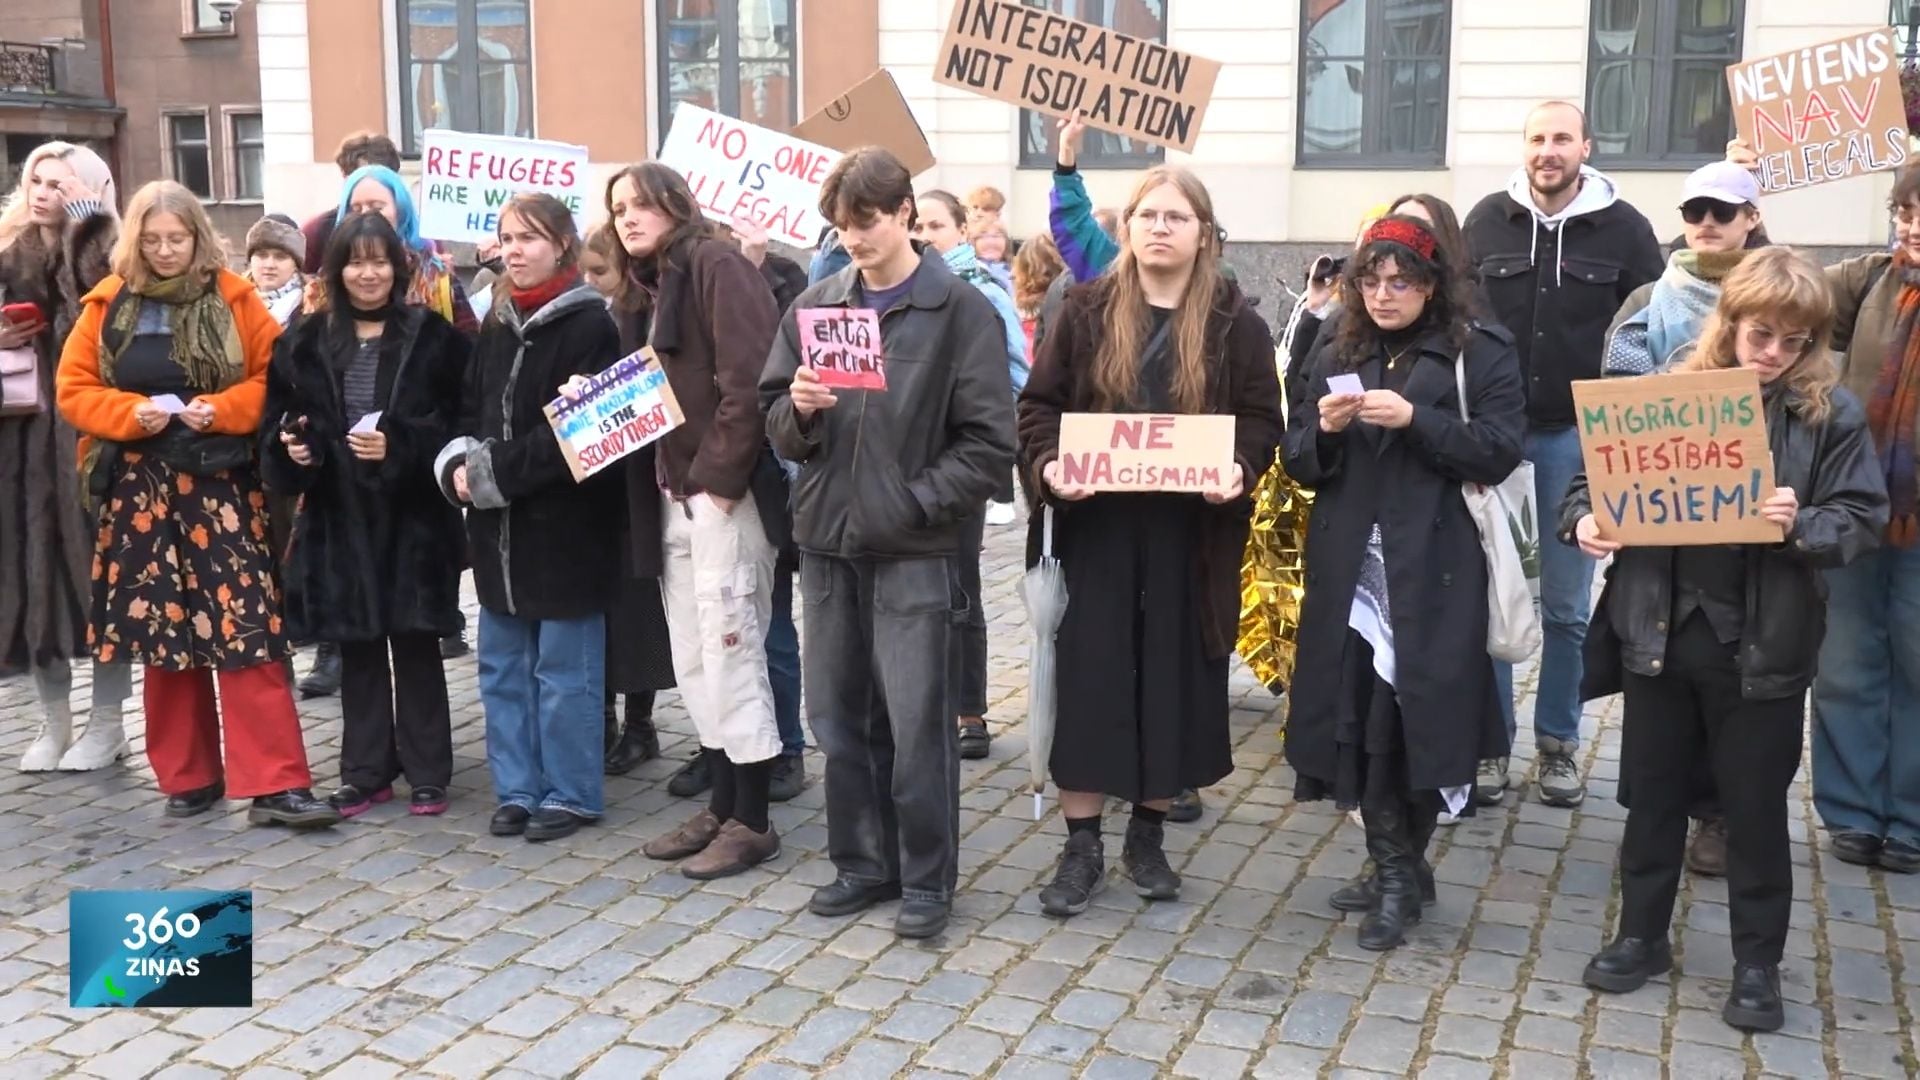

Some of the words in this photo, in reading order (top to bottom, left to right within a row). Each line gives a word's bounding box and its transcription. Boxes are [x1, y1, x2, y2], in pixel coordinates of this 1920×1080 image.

[957, 0, 1191, 94] INTEGRATION
[945, 43, 1013, 91] NOT
[1020, 63, 1196, 144] ISOLATION
[1752, 77, 1881, 153] NAV
[427, 146, 576, 188] REFUGEES
[696, 118, 747, 160] NO
[774, 146, 829, 184] ONE
[429, 183, 468, 205] ARE
[738, 160, 771, 191] IS
[598, 419, 612, 435] IS
[610, 404, 638, 428] THE
[1110, 416, 1175, 450] NĒ
